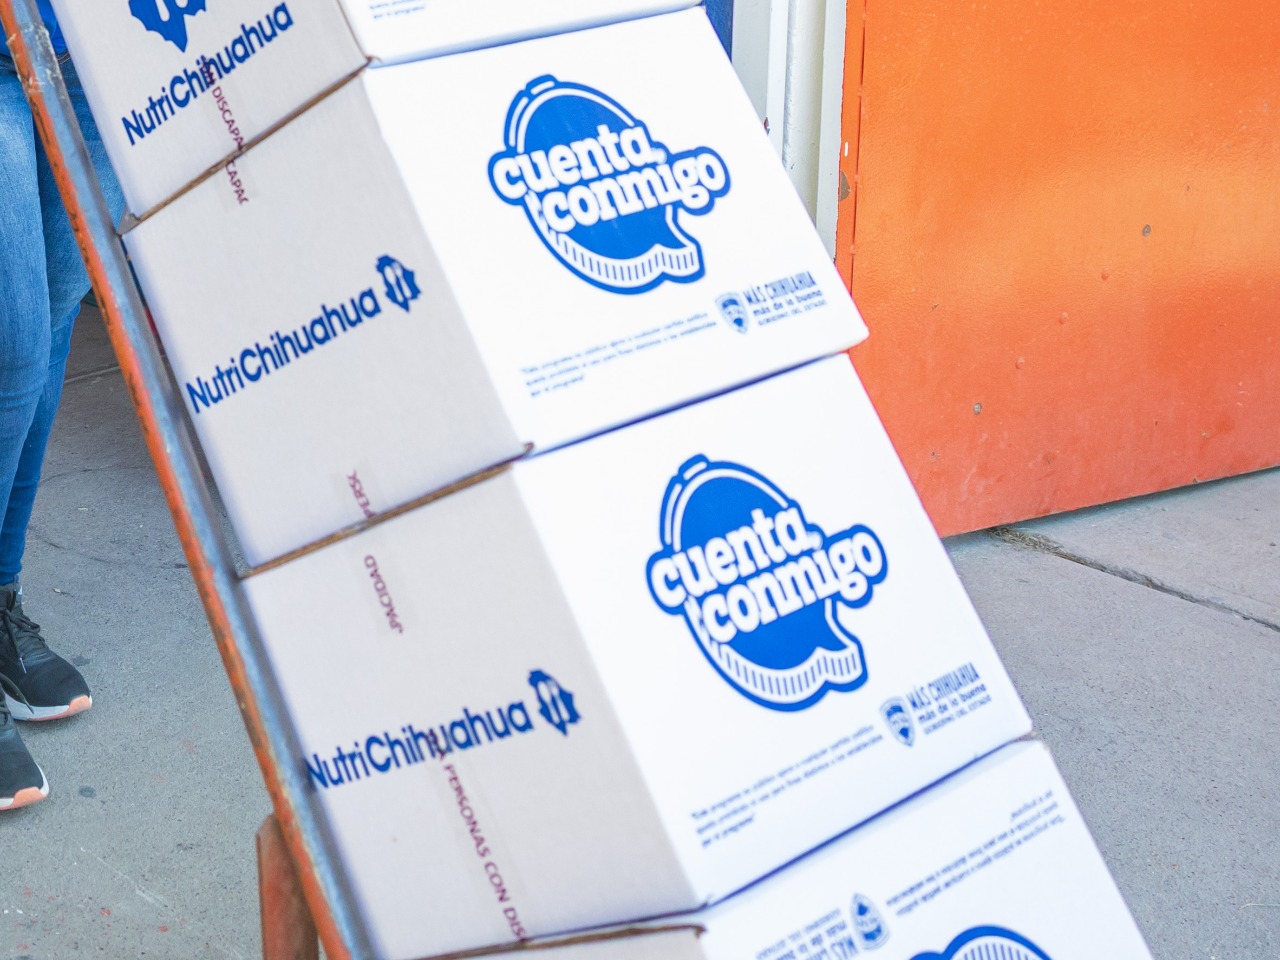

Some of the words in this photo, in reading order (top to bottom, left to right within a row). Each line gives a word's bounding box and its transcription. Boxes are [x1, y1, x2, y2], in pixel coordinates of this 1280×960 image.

[121, 1, 294, 146] NutriChihuahua
[492, 124, 654, 200] cuenta
[542, 148, 725, 232] conmigo
[186, 287, 382, 415] NutriChihuahua
[652, 507, 811, 608] cuenta
[701, 530, 883, 644] conmigo
[305, 700, 534, 789] NutriChihuahua
[443, 764, 490, 859] PERSONAS
[484, 860, 510, 904] CON
